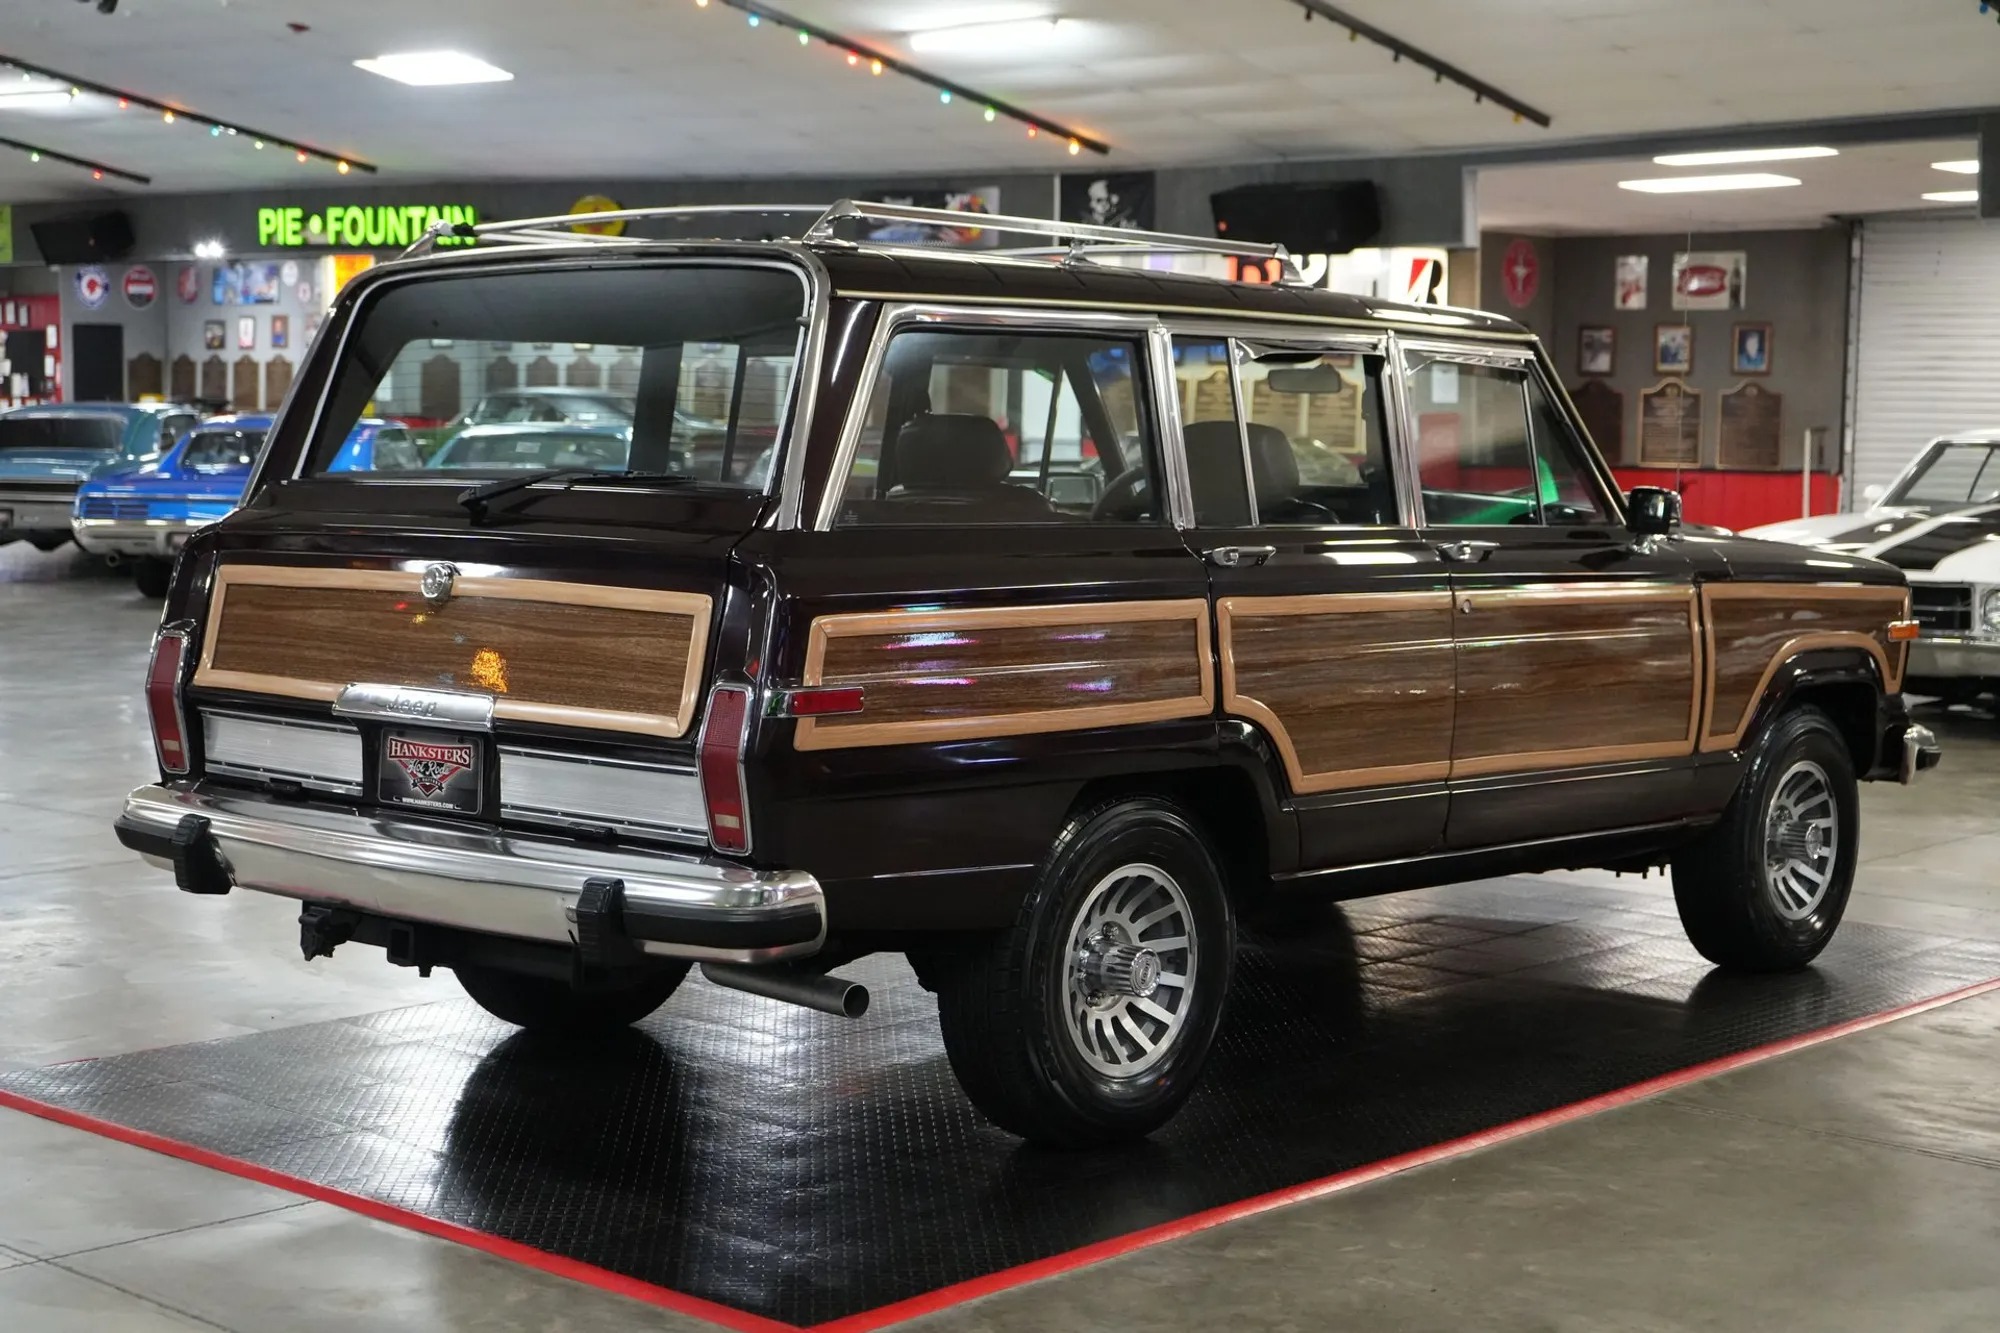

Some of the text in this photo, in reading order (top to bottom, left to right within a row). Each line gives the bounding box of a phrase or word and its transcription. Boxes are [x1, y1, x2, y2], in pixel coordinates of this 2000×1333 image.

[258, 204, 476, 246] PIE FOUNTAIN
[386, 695, 437, 716] Jeep
[390, 740, 470, 765] HANKSTERS
[407, 759, 426, 774] Hot
[402, 797, 454, 809] WWW.HANKSTERS.COM
